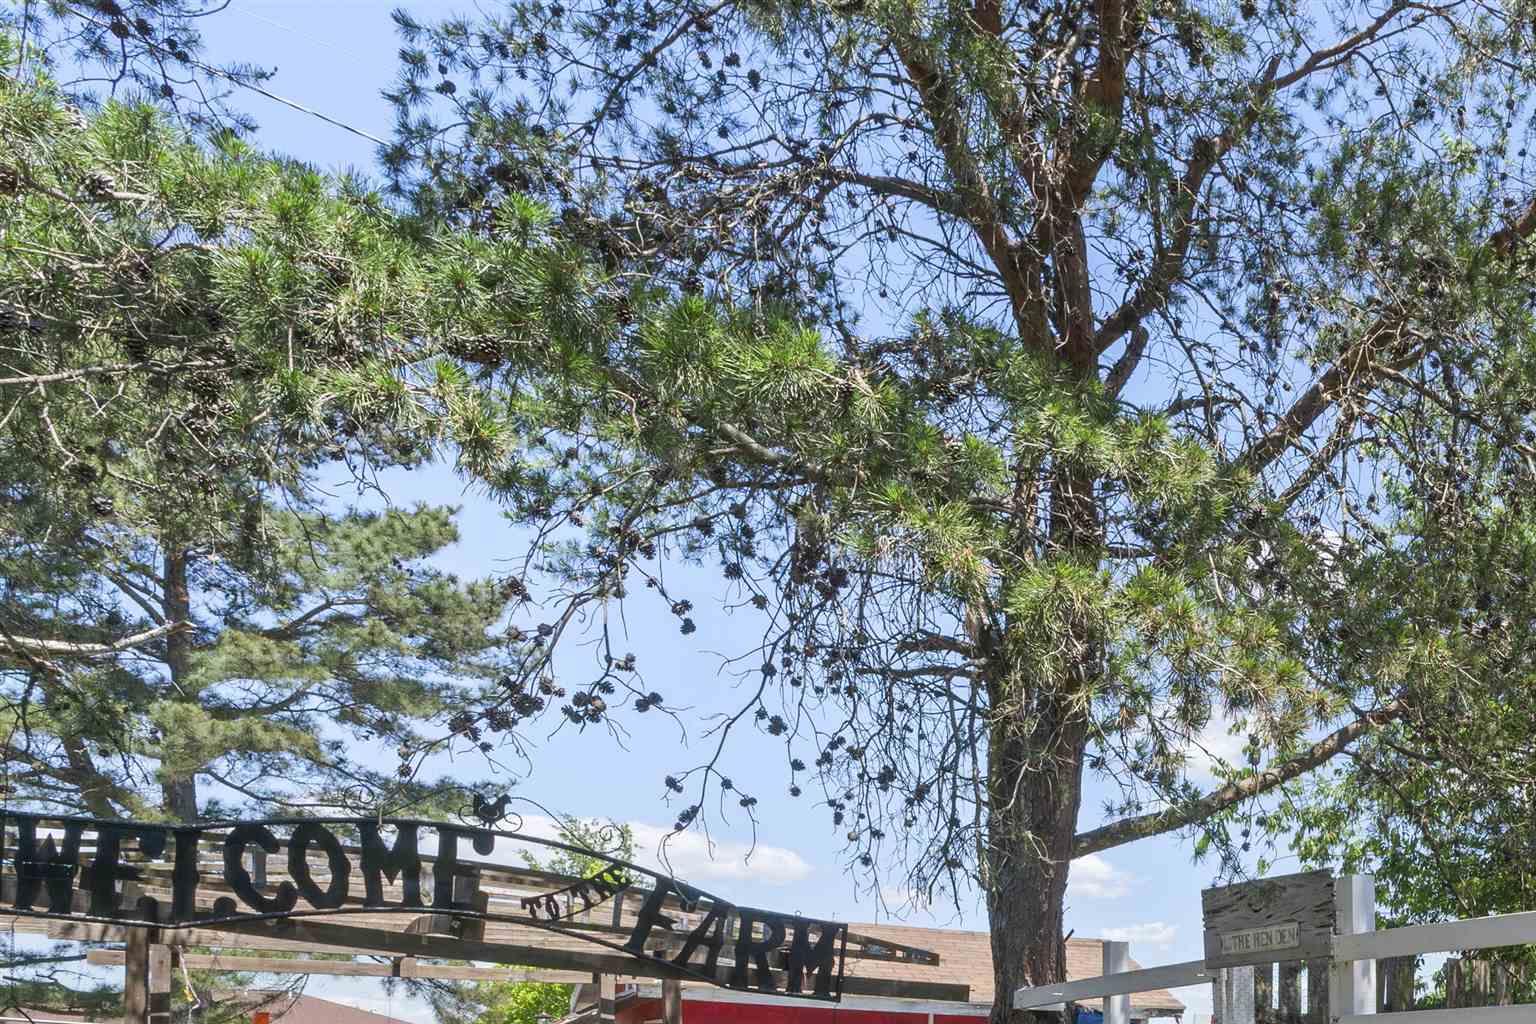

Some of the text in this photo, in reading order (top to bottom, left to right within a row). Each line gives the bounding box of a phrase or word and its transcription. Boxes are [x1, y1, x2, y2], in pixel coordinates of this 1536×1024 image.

[14, 814, 495, 922] WELCOME
[520, 896, 562, 922] TO
[623, 876, 842, 1000] FARM
[1231, 934, 1251, 951] THE
[1253, 931, 1273, 948] HEN
